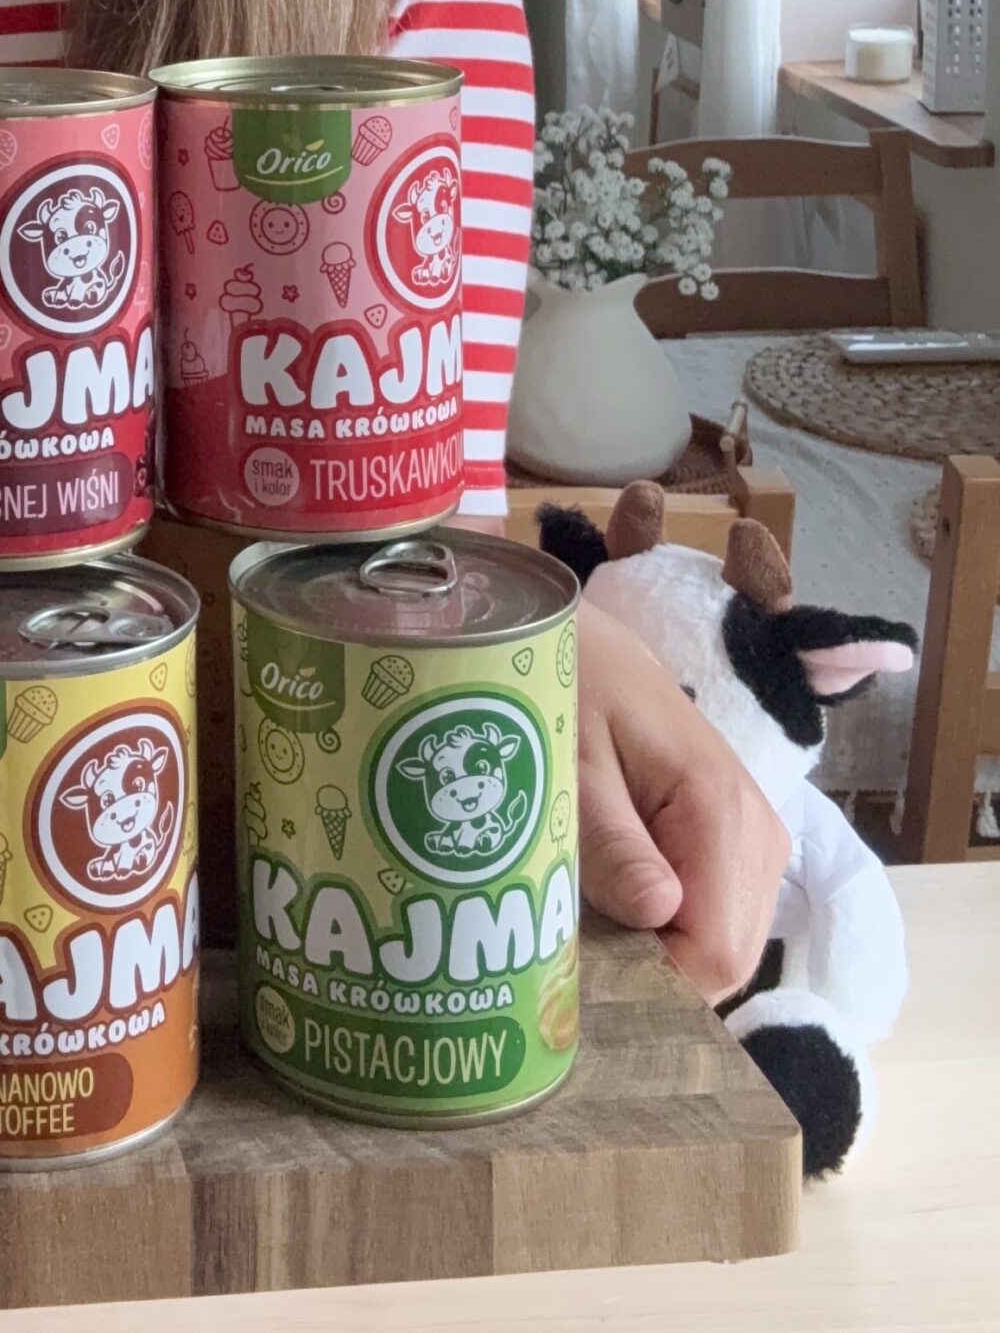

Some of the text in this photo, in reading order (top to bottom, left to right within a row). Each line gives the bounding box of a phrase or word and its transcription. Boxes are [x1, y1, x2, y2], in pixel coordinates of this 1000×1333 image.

[256, 147, 332, 175] Orico
[245, 396, 458, 440] MASA KRÓWKOWA
[252, 457, 294, 479] smak
[261, 478, 293, 497] kolor
[57, 468, 120, 516] WIŚNI
[261, 662, 324, 700] Orico
[252, 856, 579, 983] KAJMA
[256, 945, 514, 1015] MASA KRÓWKOWA
[304, 1017, 508, 1087] PISTACJOWY
